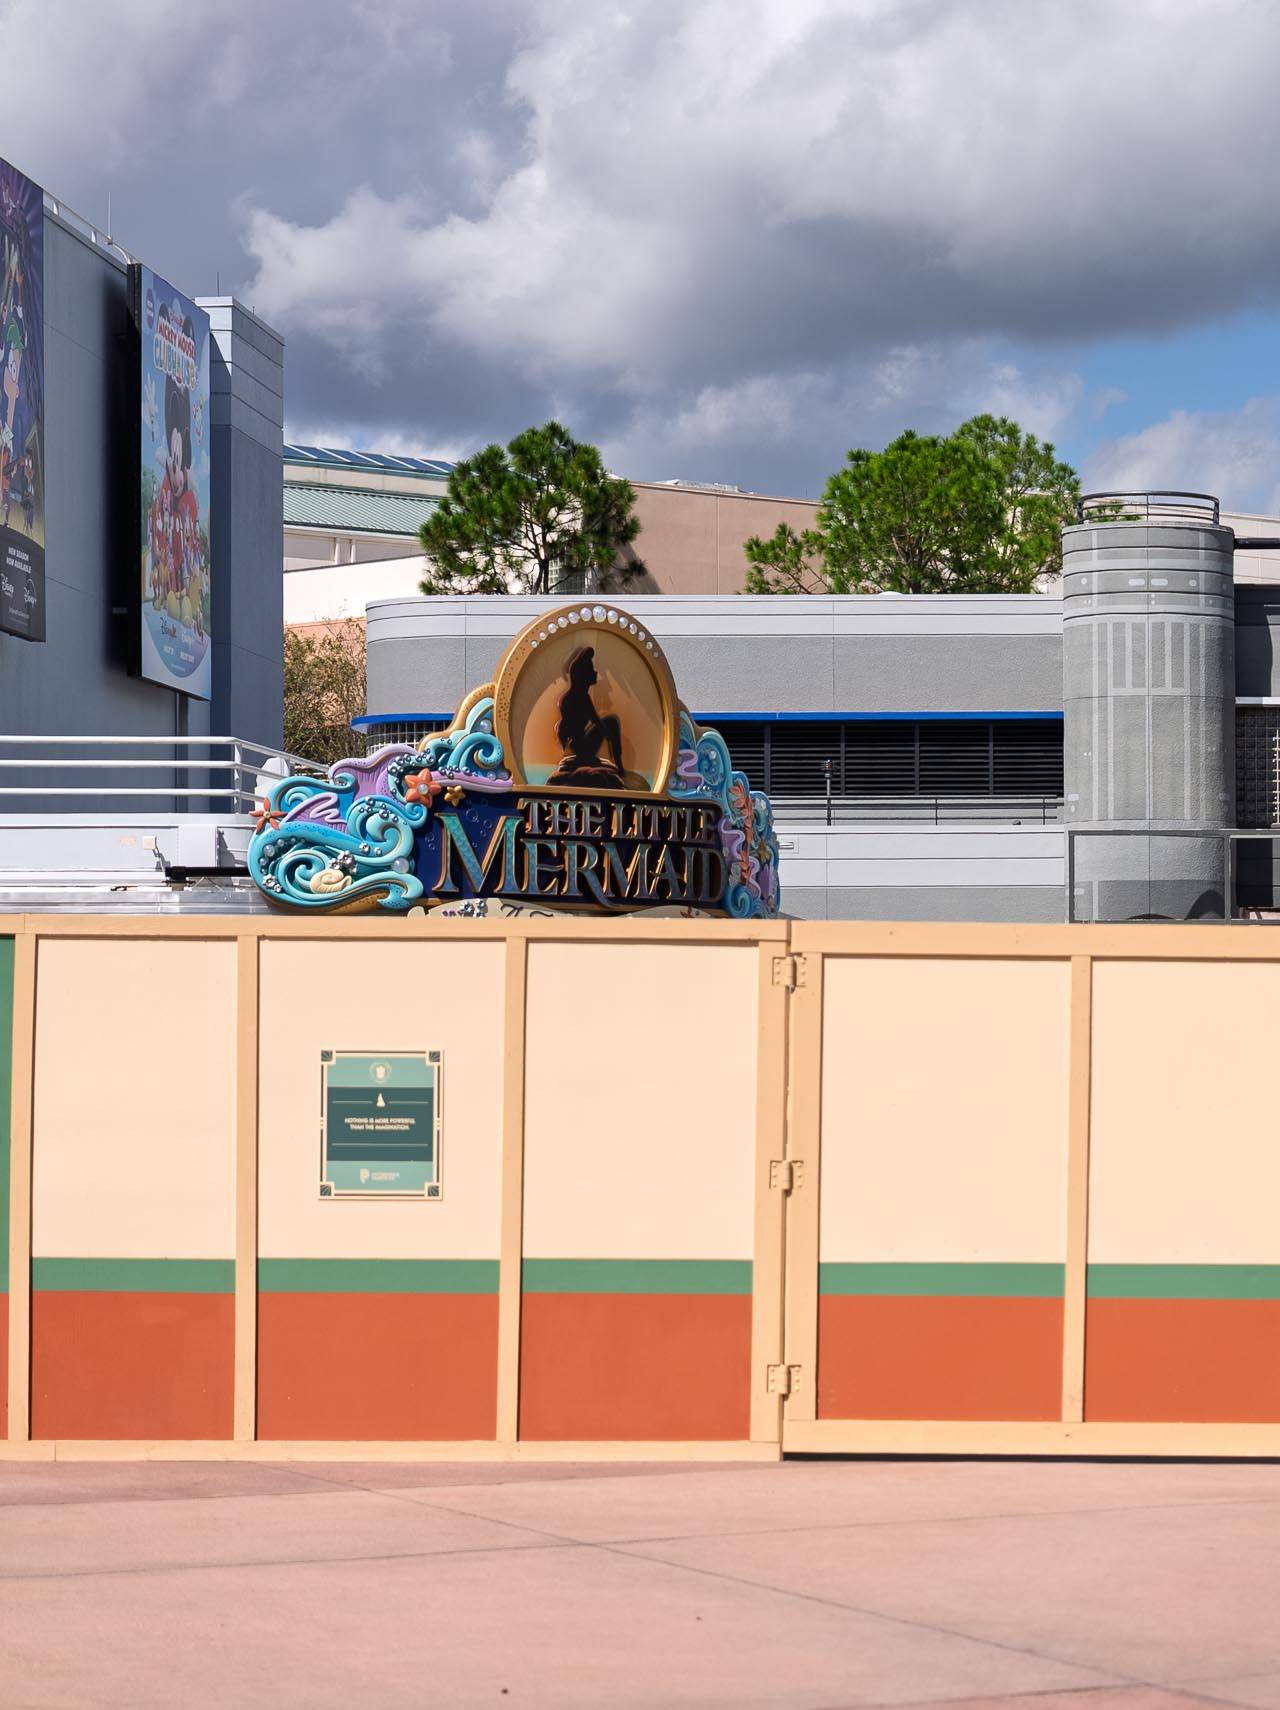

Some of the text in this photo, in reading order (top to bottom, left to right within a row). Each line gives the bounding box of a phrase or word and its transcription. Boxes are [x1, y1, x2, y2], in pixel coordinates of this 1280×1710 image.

[517, 799, 716, 844] THE LITTLE
[432, 812, 728, 908] MERMAID
